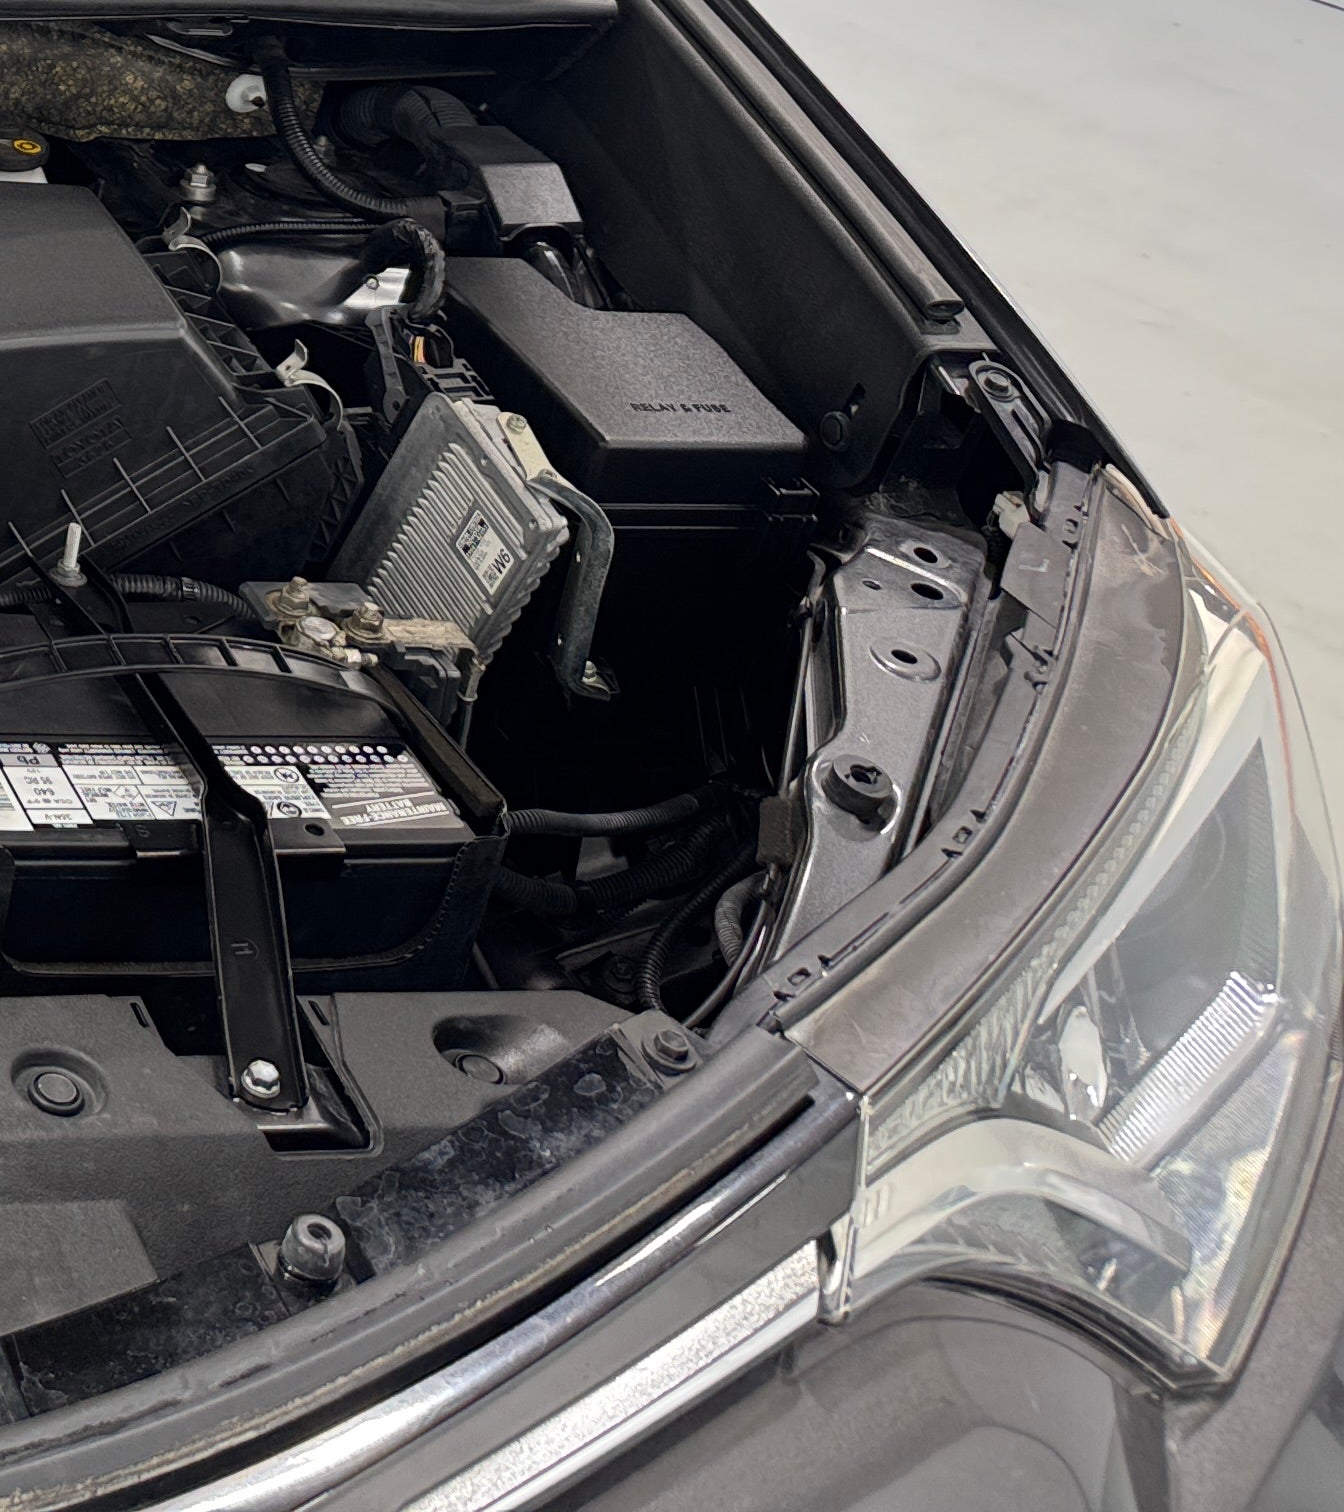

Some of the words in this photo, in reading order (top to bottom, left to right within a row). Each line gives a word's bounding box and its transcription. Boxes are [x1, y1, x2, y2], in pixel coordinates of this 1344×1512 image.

[629, 402, 676, 413] RELAY
[692, 403, 732, 413] FUSE
[491, 548, 512, 575] W6
[16, 755, 40, 765] Pb
[365, 798, 415, 813] BATTERY
